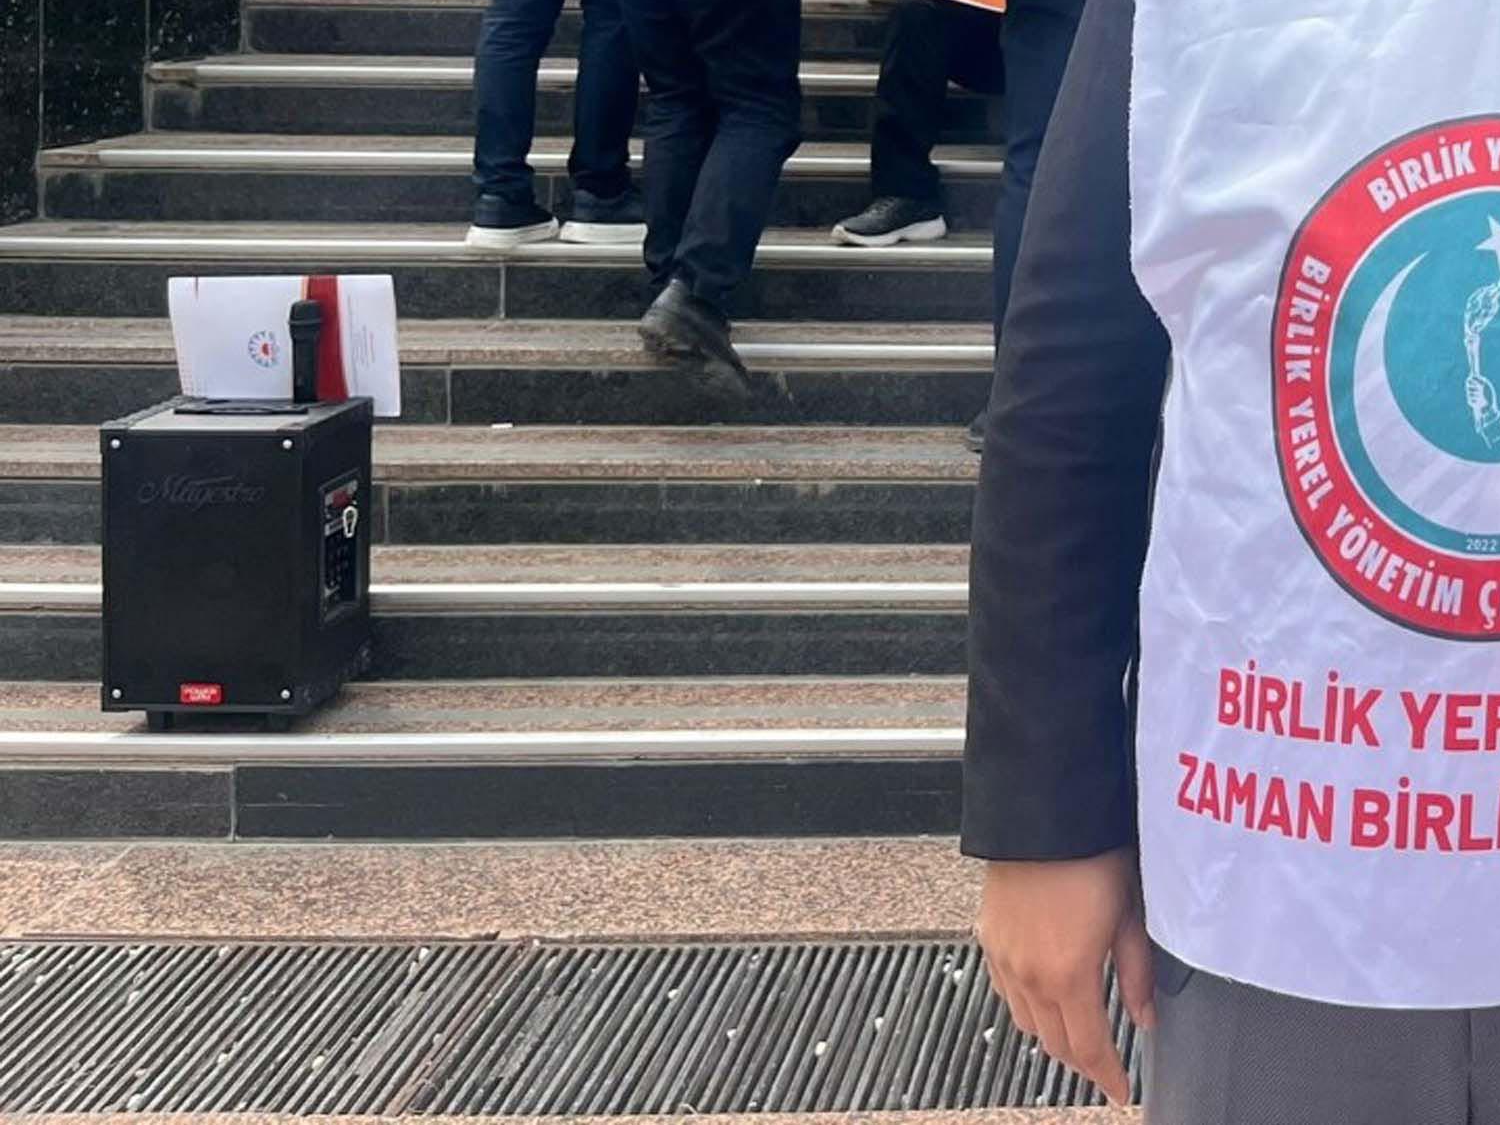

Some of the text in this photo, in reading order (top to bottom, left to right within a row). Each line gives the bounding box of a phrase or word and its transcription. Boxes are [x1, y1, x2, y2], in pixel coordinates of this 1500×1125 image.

[1366, 136, 1477, 213] BİRLİK
[1284, 254, 1333, 385] BİRLİK
[1286, 397, 1336, 512] YEREL
[1324, 502, 1464, 617] YÖNETİM
[1465, 538, 1499, 553] 2022
[1217, 659, 1383, 748] BİRLİK
[1176, 752, 1335, 844] ZAMAN
